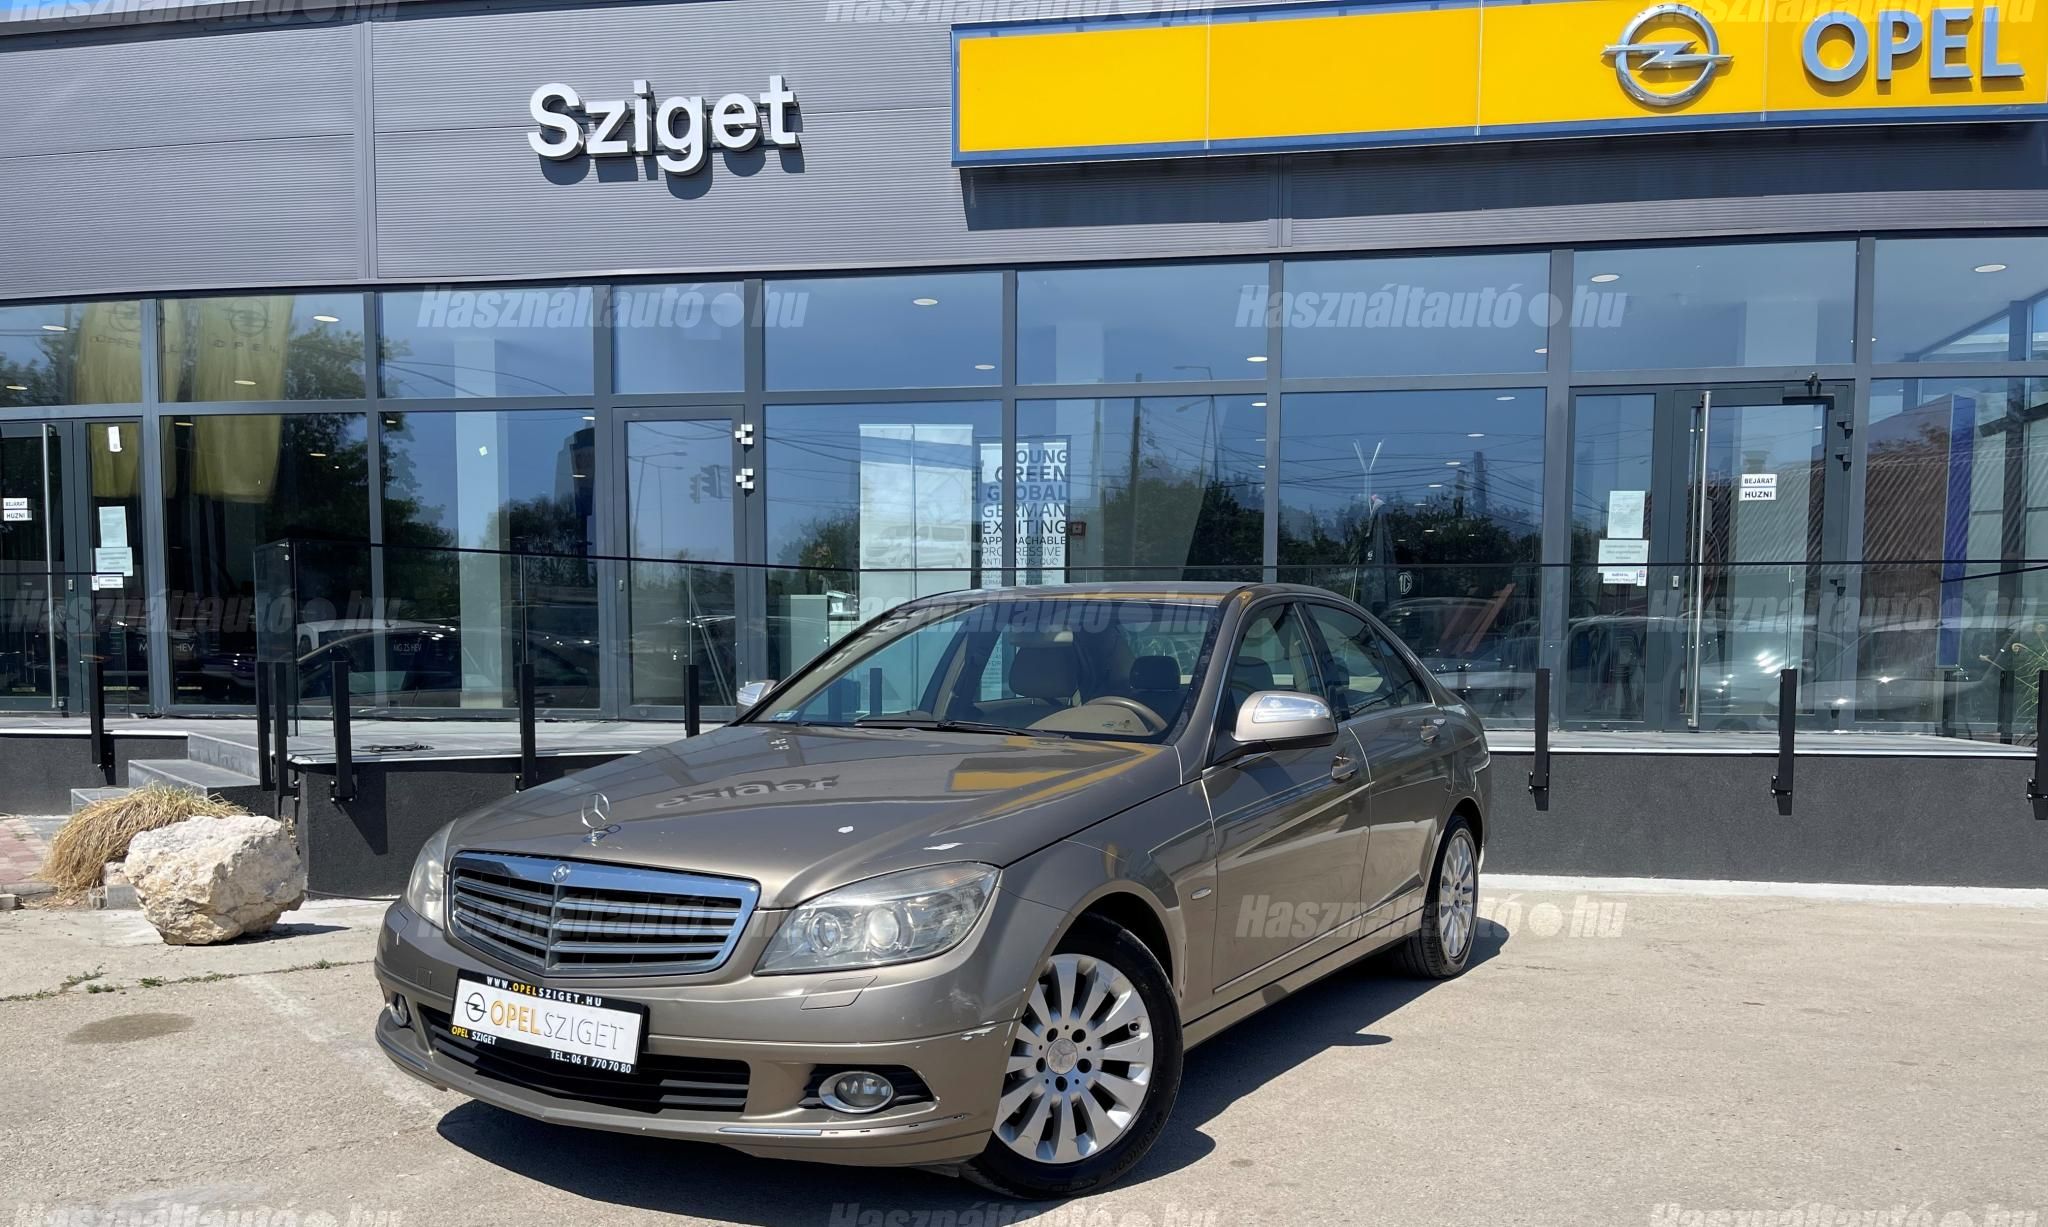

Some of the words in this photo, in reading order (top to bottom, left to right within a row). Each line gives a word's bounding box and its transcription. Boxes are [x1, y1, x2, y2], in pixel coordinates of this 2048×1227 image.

[1803, 7, 2025, 83] OPEL
[527, 75, 798, 175] Sziget
[1015, 449, 1067, 464] OUNG
[987, 484, 1067, 501] GOBAL
[982, 502, 1067, 518] GEMAN
[982, 519, 1067, 534] EXITING
[982, 536, 1067, 545] APPACHABLE
[982, 546, 1061, 557] PRORESSIVE
[486, 976, 602, 1006] WWW.OPELSZIGET.HU
[451, 1026, 469, 1038] OPEL
[471, 1031, 497, 1046] SZIGET
